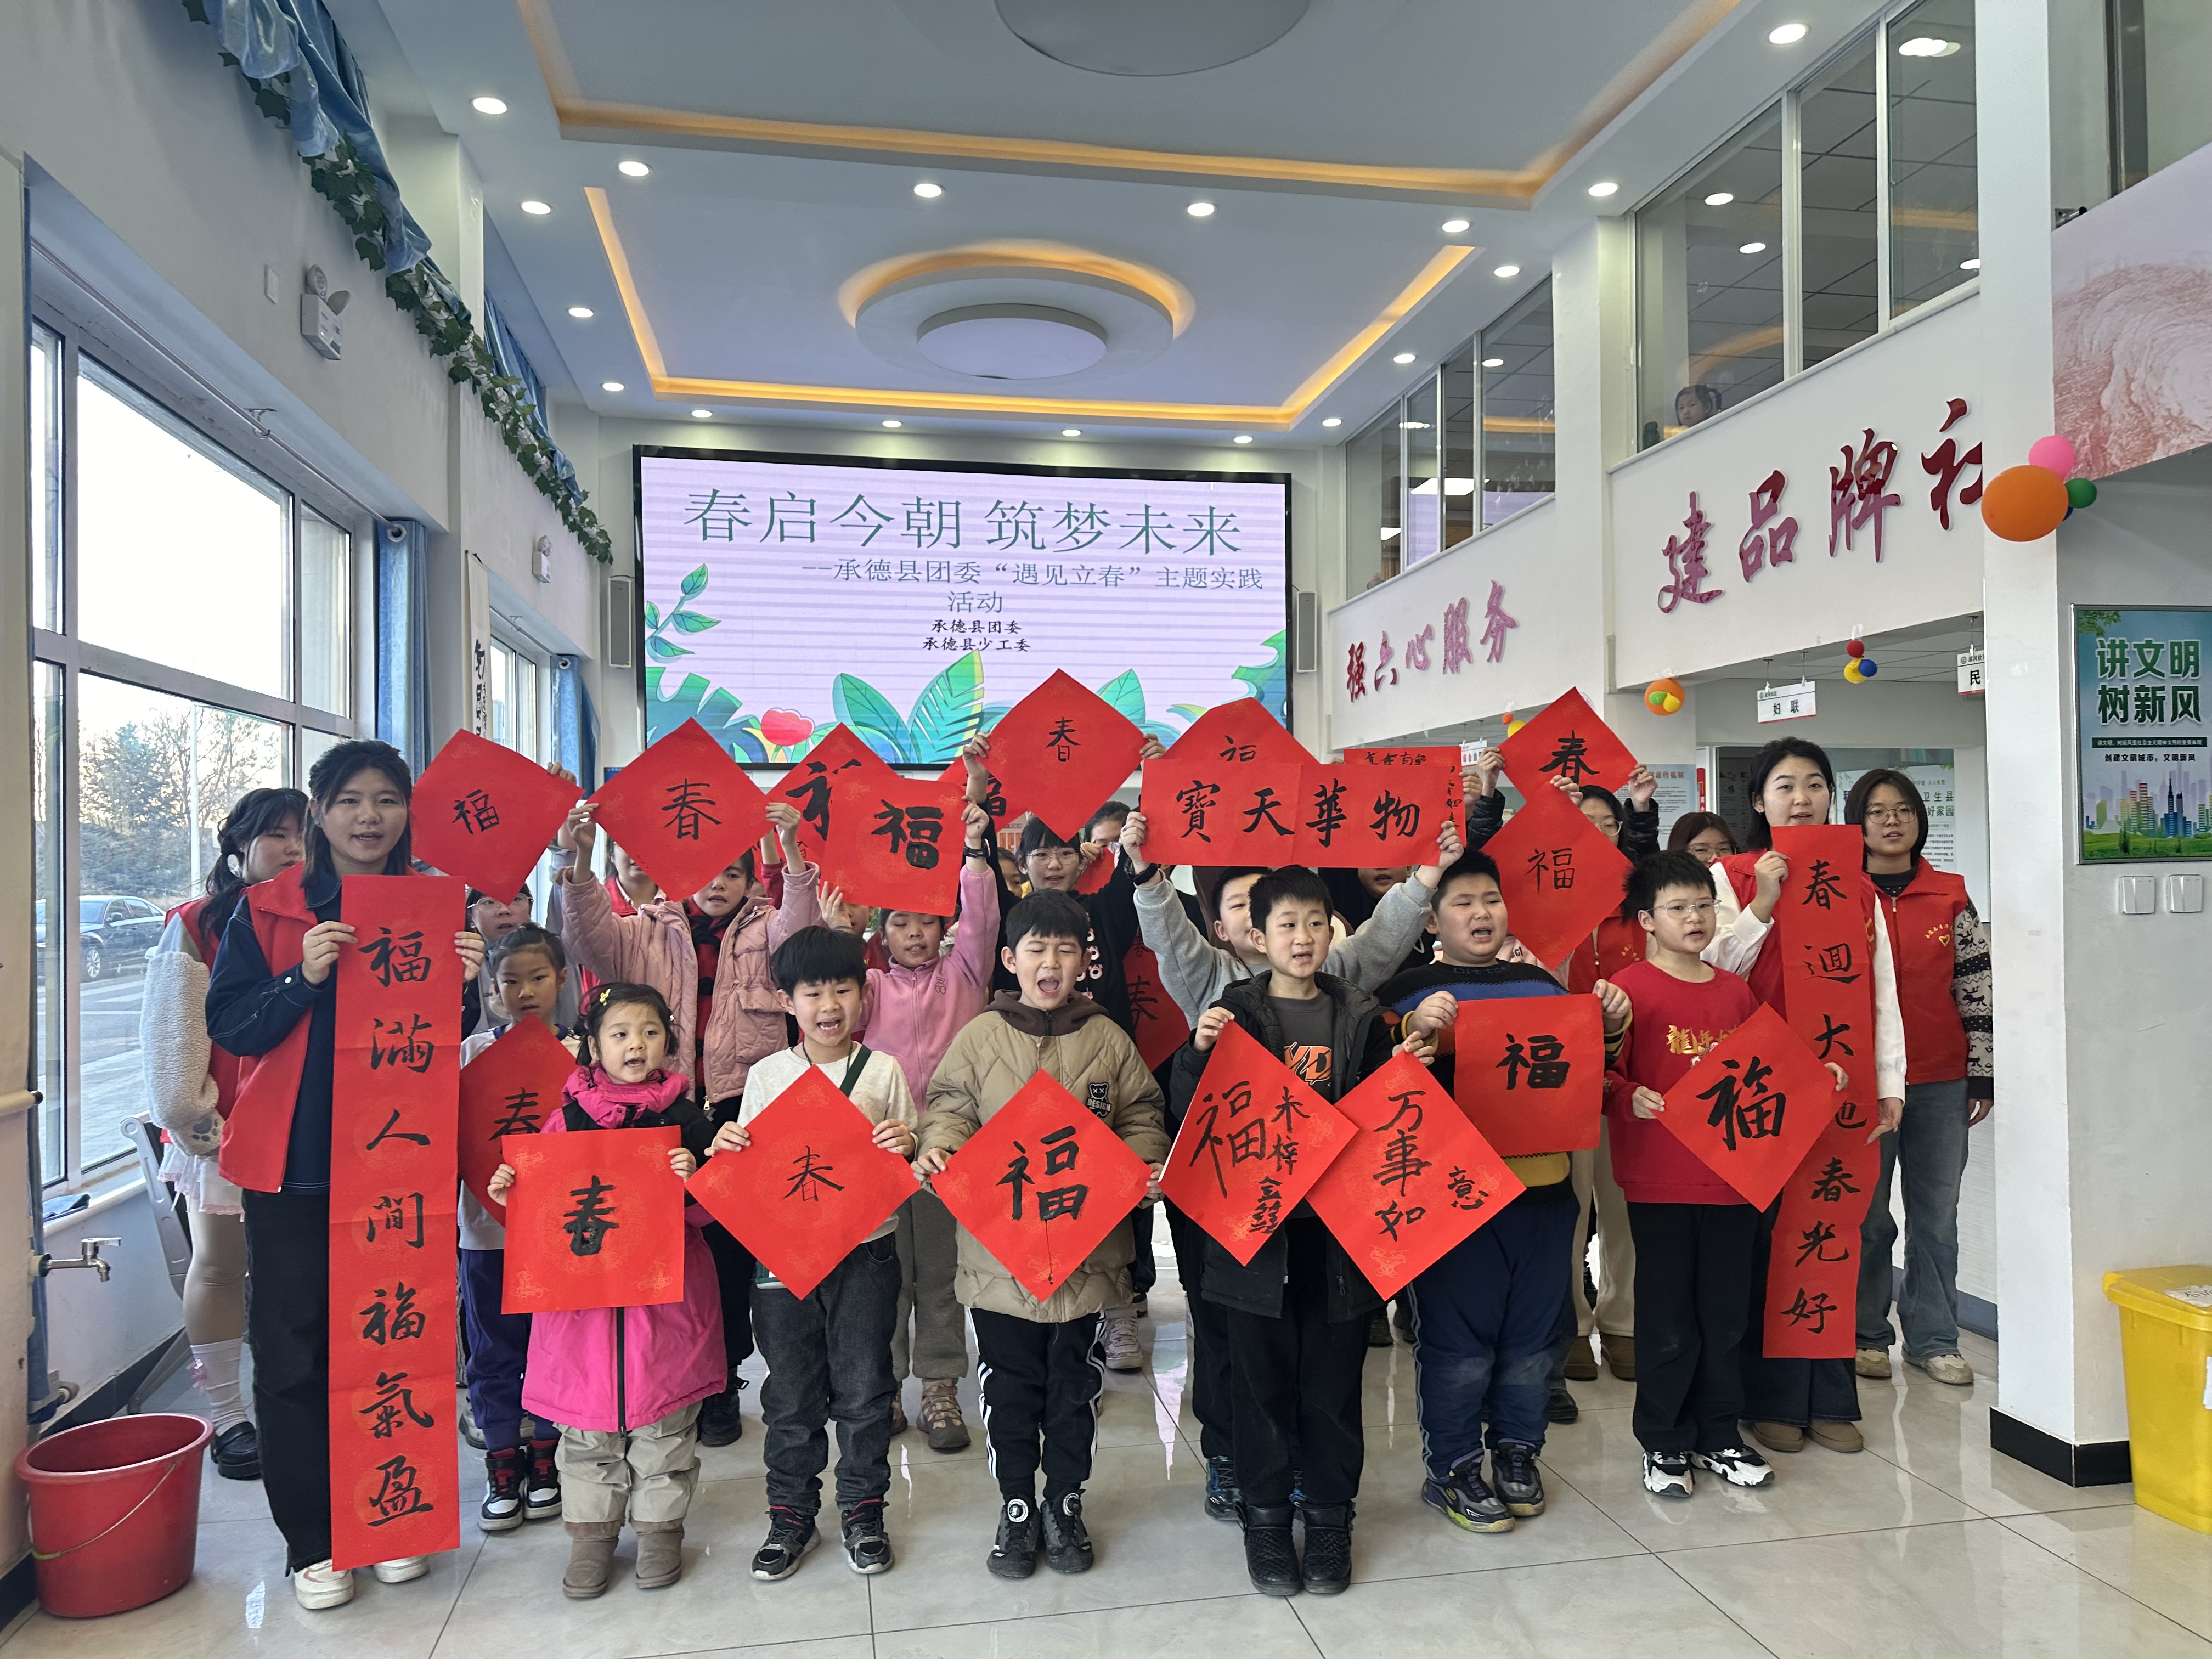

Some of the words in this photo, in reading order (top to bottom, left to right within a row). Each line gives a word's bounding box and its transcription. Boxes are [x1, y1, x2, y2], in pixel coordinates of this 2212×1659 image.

[684, 488, 962, 549] 春启今朝
[984, 498, 1242, 556] 筑梦未来
[947, 590, 1003, 613] 活动
[922, 637, 1031, 652] 承德县少工委
[931, 619, 1022, 635] 承德县团委
[2096, 638, 2201, 679] 讲文明
[1773, 699, 1799, 716] 妇联
[2098, 684, 2202, 724] 树新风
[1045, 716, 1080, 763] 春
[1539, 730, 1600, 786] 春
[453, 789, 500, 835] 福
[661, 778, 723, 840] 春
[1922, 790, 1954, 802] 卫生县
[1927, 805, 1954, 817] 好家园
[871, 798, 944, 870] 福
[1526, 847, 1576, 894] 福
[1496, 1032, 1571, 1091] 福
[1087, 1098, 1111, 1112] DESIGN
[1696, 1056, 1787, 1152] 福
[1189, 1080, 1267, 1199] 福
[783, 1146, 845, 1203] 春
[996, 1125, 1091, 1222] 福
[563, 1175, 620, 1257] 春
